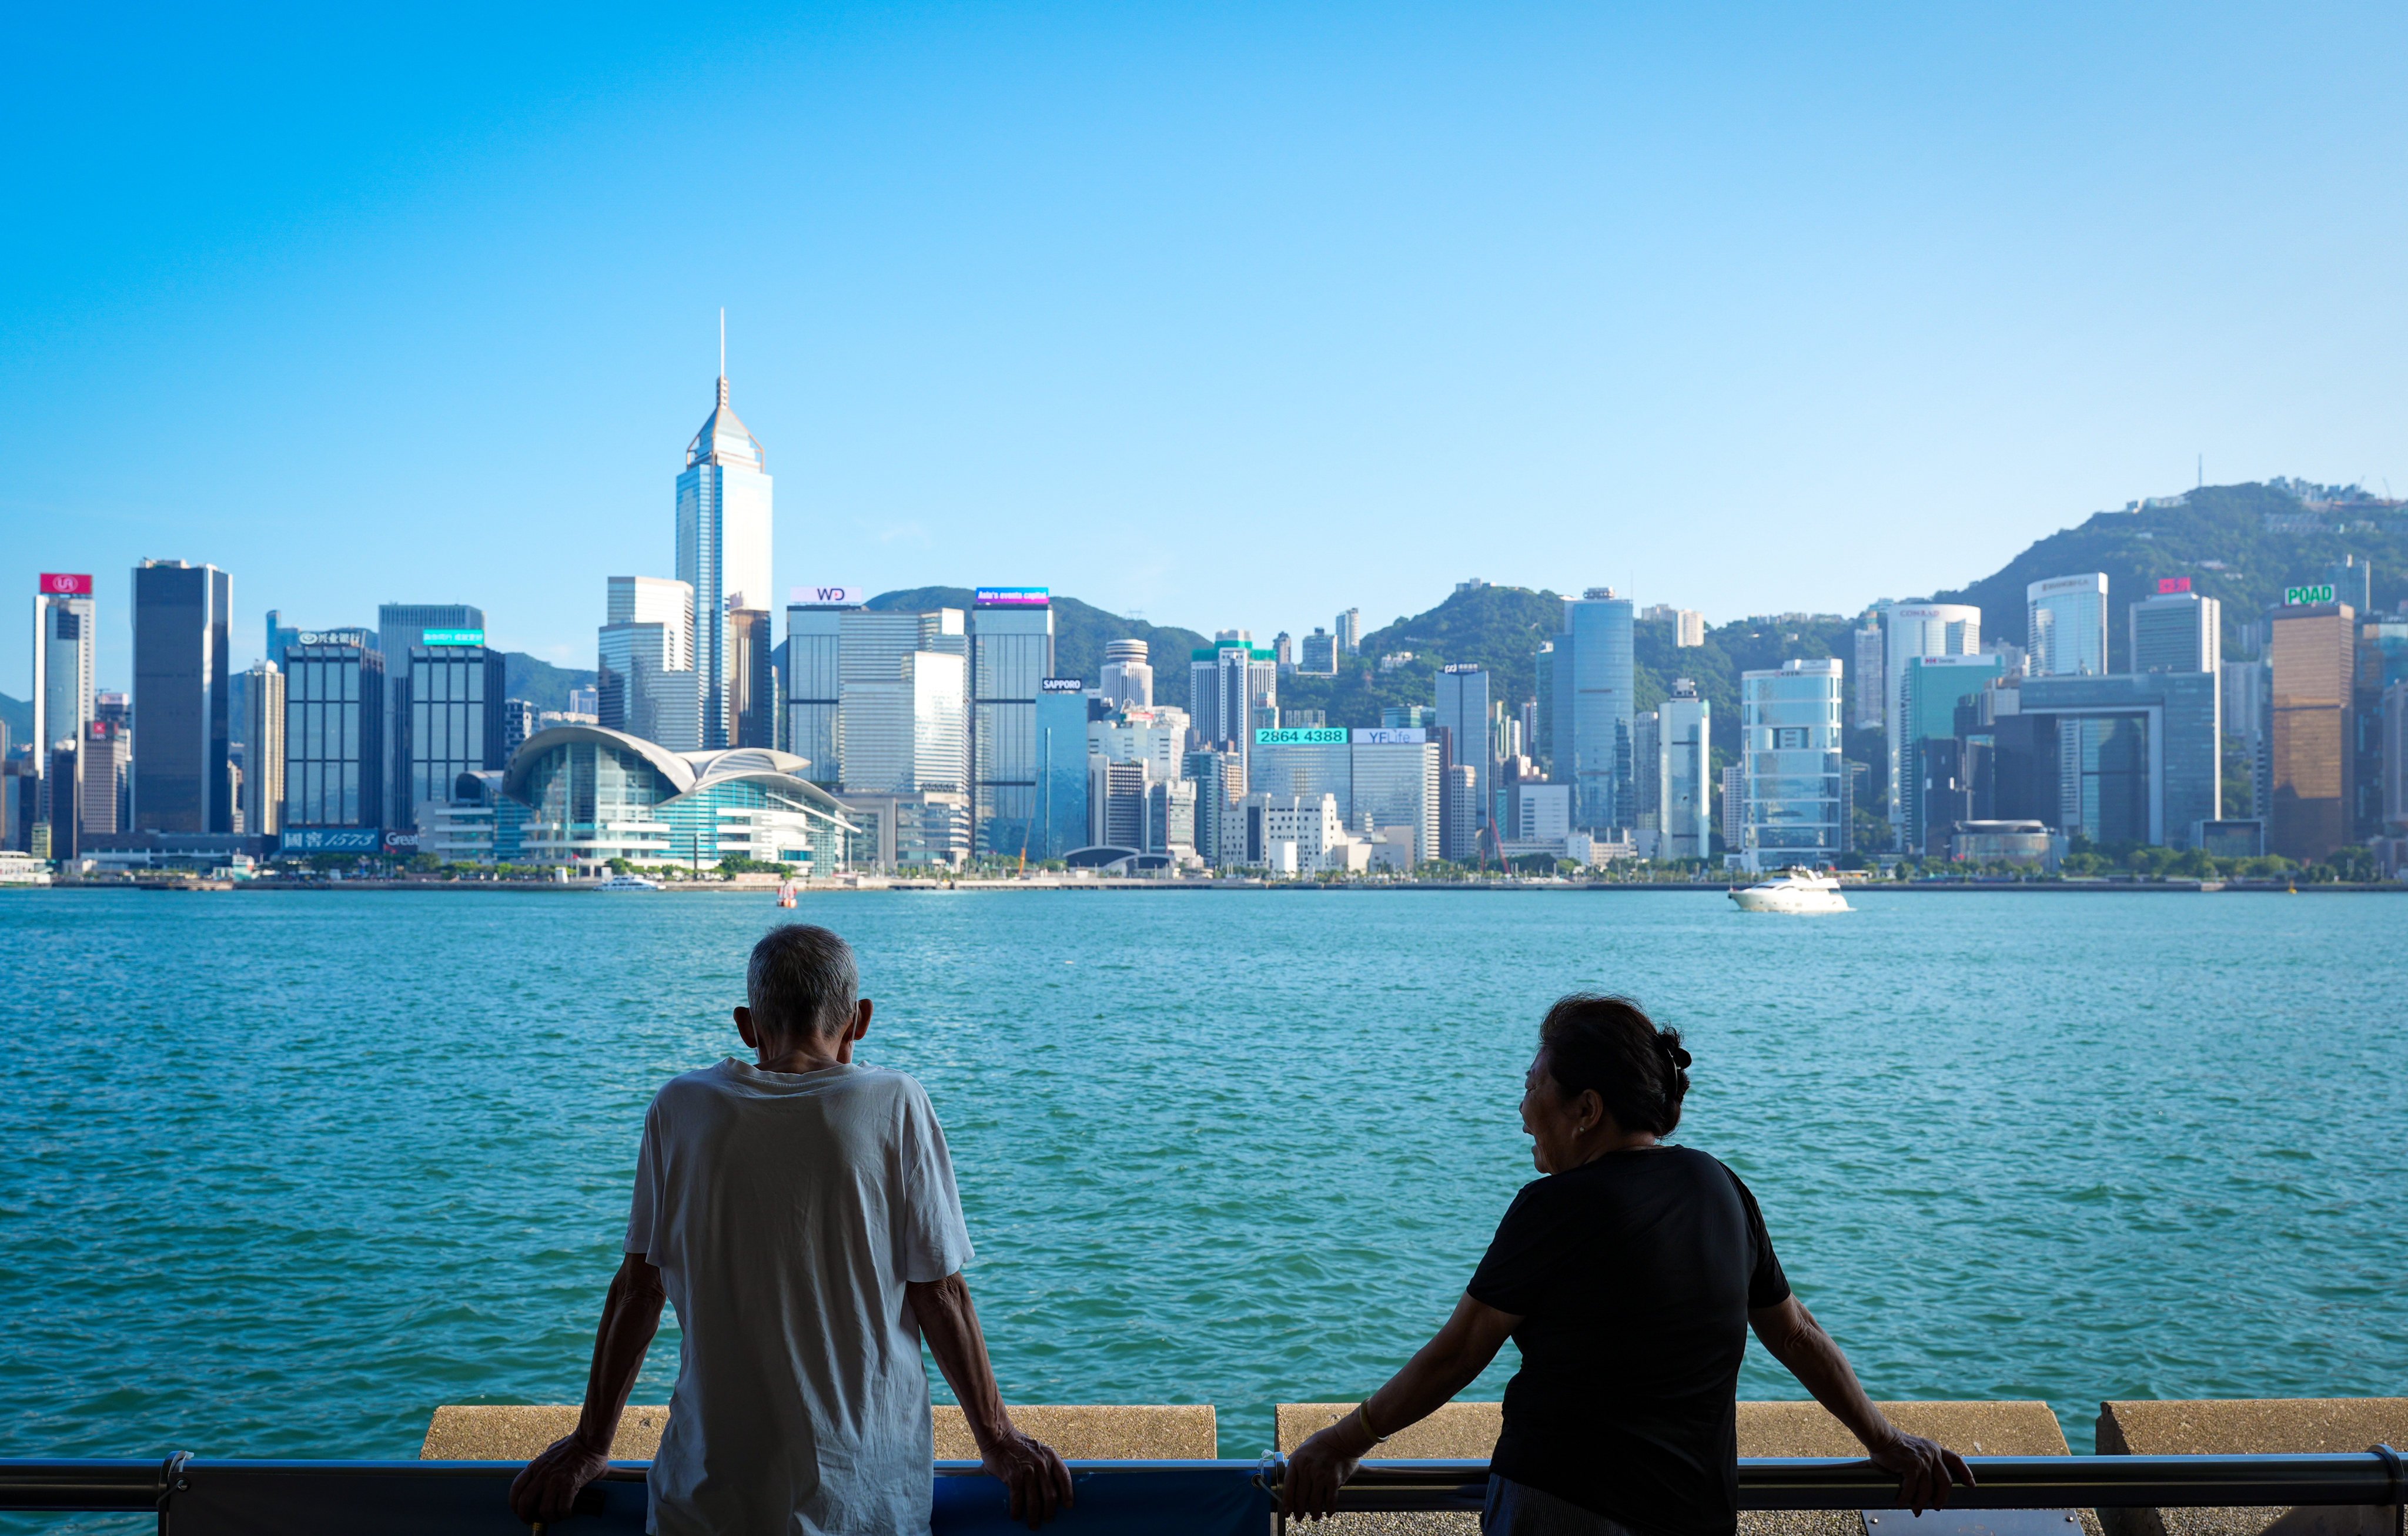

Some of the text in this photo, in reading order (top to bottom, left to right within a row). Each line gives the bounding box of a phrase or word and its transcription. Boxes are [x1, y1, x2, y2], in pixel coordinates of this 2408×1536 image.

[2288, 586, 2332, 605] POAD
[1043, 680, 1081, 690] SAPPORO
[1260, 730, 1342, 742] 2864 4388
[325, 833, 375, 846] 1573
